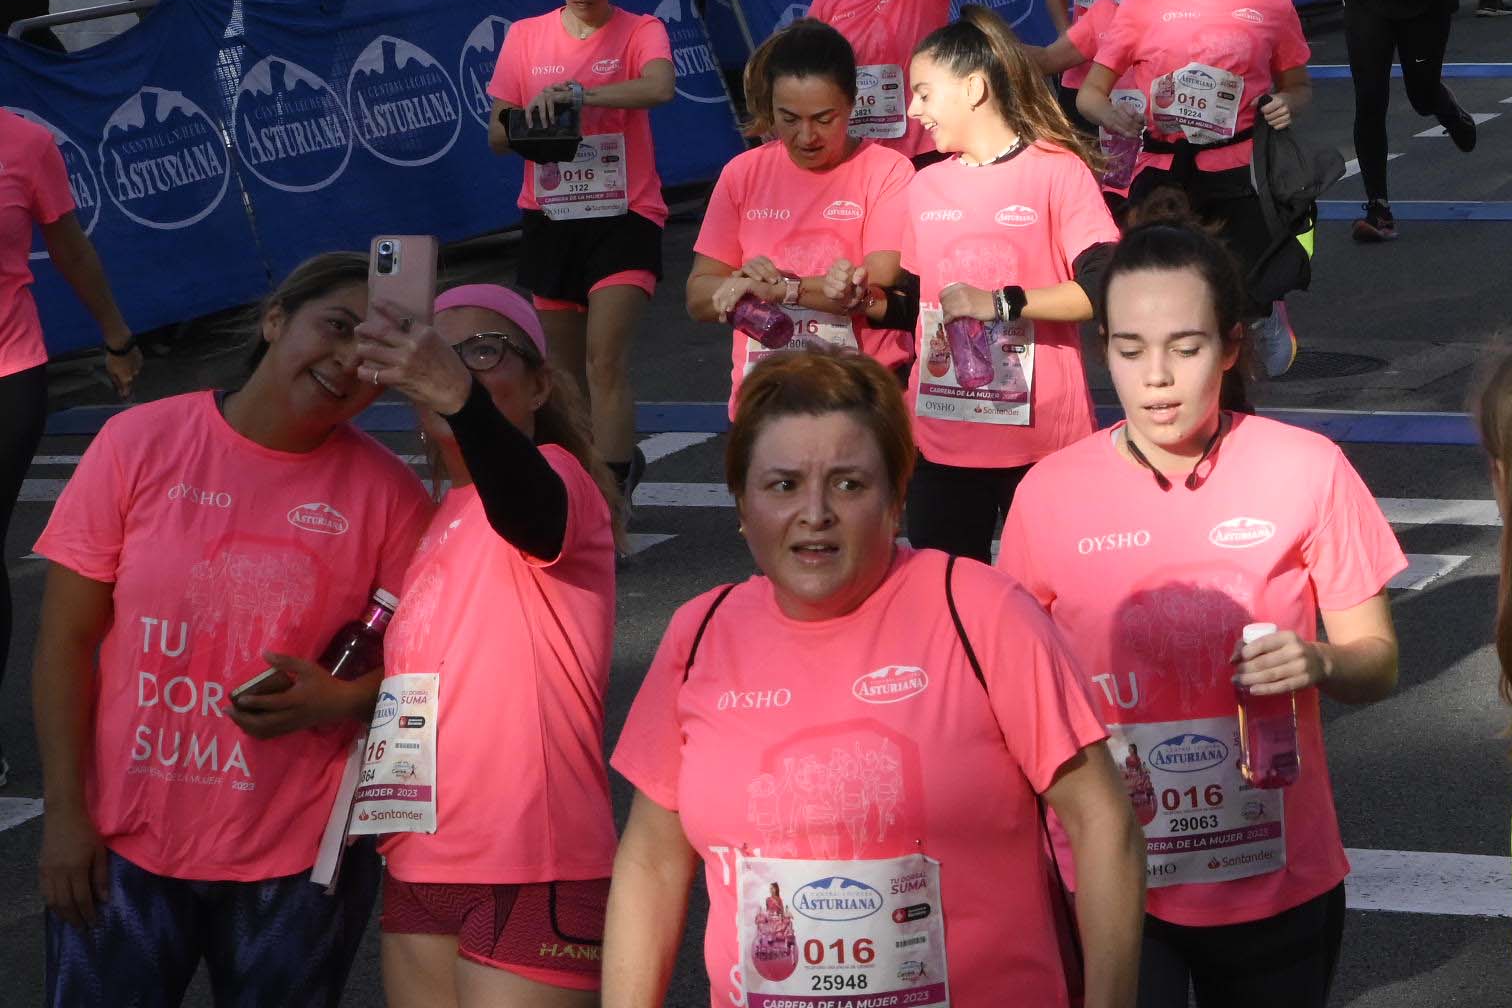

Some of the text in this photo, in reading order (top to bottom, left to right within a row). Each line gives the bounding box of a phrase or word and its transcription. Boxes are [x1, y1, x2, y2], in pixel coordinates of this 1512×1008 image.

[532, 65, 565, 76] OYSHO
[1181, 74, 1213, 89] ASTURIANA
[858, 95, 876, 106] 16
[1177, 93, 1208, 110] 016
[357, 89, 457, 140] ASTURIANA
[1179, 107, 1202, 119] 19224
[243, 112, 347, 165] ASTURIANA
[110, 141, 224, 202] ASTURIANA
[563, 168, 594, 181] 016
[569, 183, 589, 192] 3122
[747, 208, 791, 221] OYSHO
[921, 210, 963, 222] OYSHO
[794, 319, 819, 334] 16
[929, 386, 955, 396] CARRERA
[976, 391, 1000, 400] MUJER
[925, 400, 955, 412] OYSHO
[168, 482, 231, 508] OYSHO
[293, 510, 344, 532] ASTURIANA
[1078, 530, 1151, 555] OYSHO
[141, 616, 188, 658] TU
[138, 671, 224, 718] DOR
[859, 676, 923, 696] ASTURIANA
[1092, 671, 1139, 709] TU
[401, 695, 428, 705] SUMA
[718, 688, 792, 711] OYSHO
[131, 725, 251, 777] SUMA
[368, 740, 386, 762] 16
[1156, 748, 1224, 766] ASTURIANA
[232, 780, 256, 791] 2023
[1161, 783, 1224, 811] 016
[370, 810, 423, 821] Santander
[1170, 814, 1219, 833] 29063
[1147, 842, 1174, 851] RERA
[1176, 839, 1191, 849] DE
[1193, 838, 1207, 848] LA
[1209, 833, 1244, 845] MUJER
[1222, 850, 1274, 867] Santander
[890, 879, 928, 895] SUMA
[799, 894, 876, 910] ASTURIANA
[540, 943, 600, 961] HANK
[803, 937, 876, 966] 016
[811, 974, 868, 991] 25948
[838, 999, 854, 1008] LA
[856, 996, 898, 1008] MUJER
[903, 991, 930, 1003] 2023
